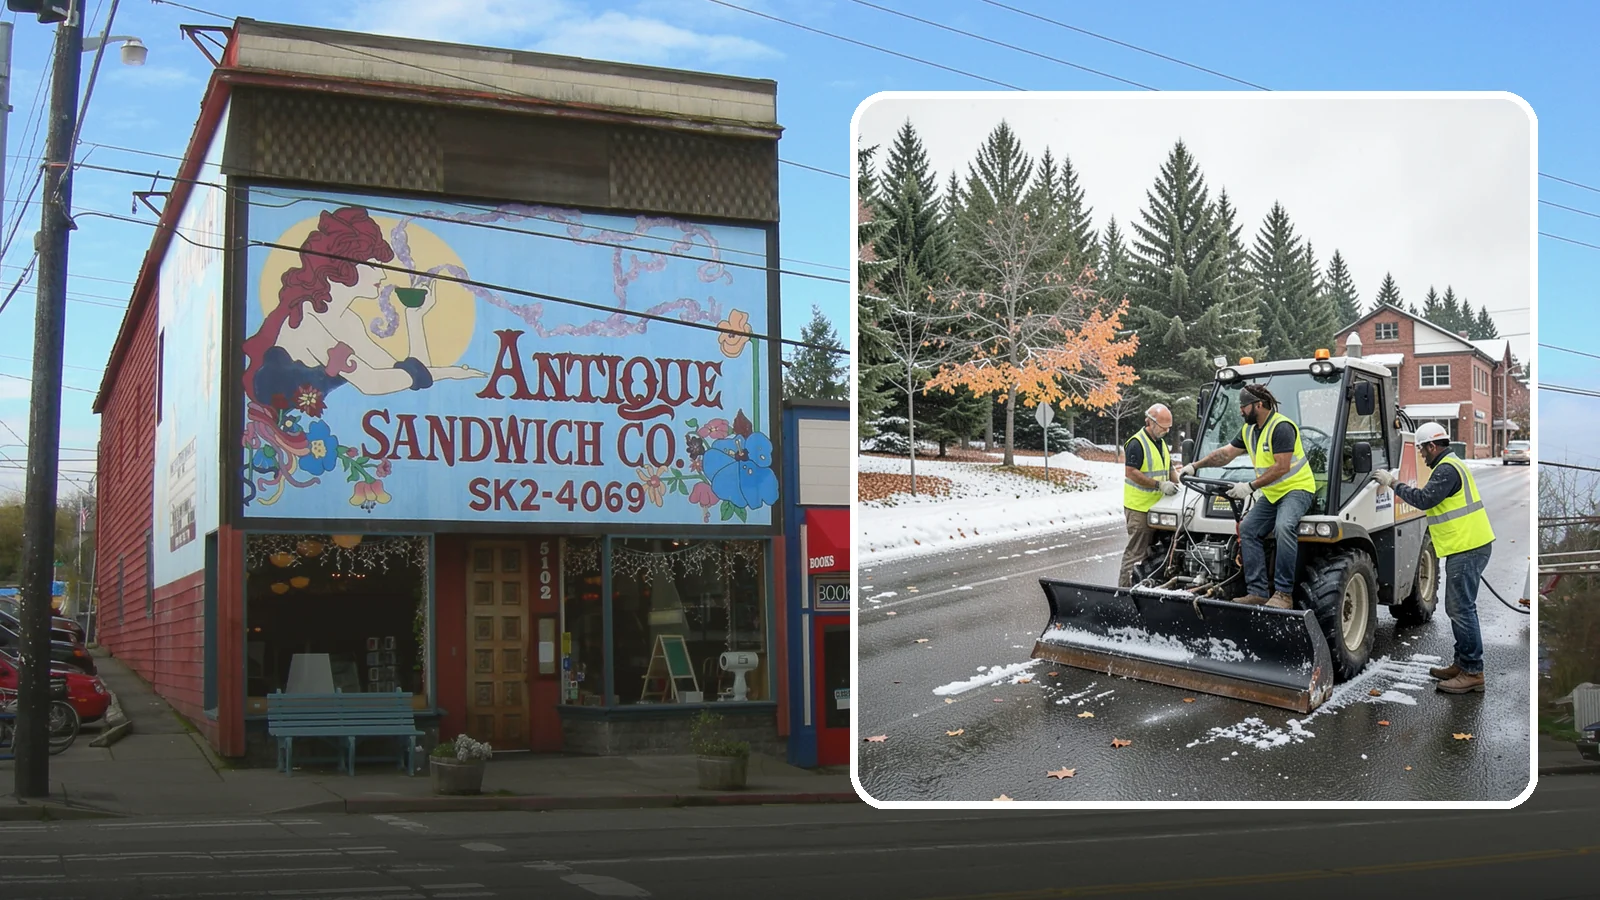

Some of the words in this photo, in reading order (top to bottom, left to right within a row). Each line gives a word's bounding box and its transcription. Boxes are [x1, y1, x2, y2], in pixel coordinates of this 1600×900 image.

[476, 329, 723, 420] ANTIQUE
[361, 409, 604, 467] SANDWICH
[617, 421, 685, 468] CO.
[468, 477, 645, 513] SK2-4069
[540, 542, 553, 598] 5102
[809, 555, 834, 568] BOOKS
